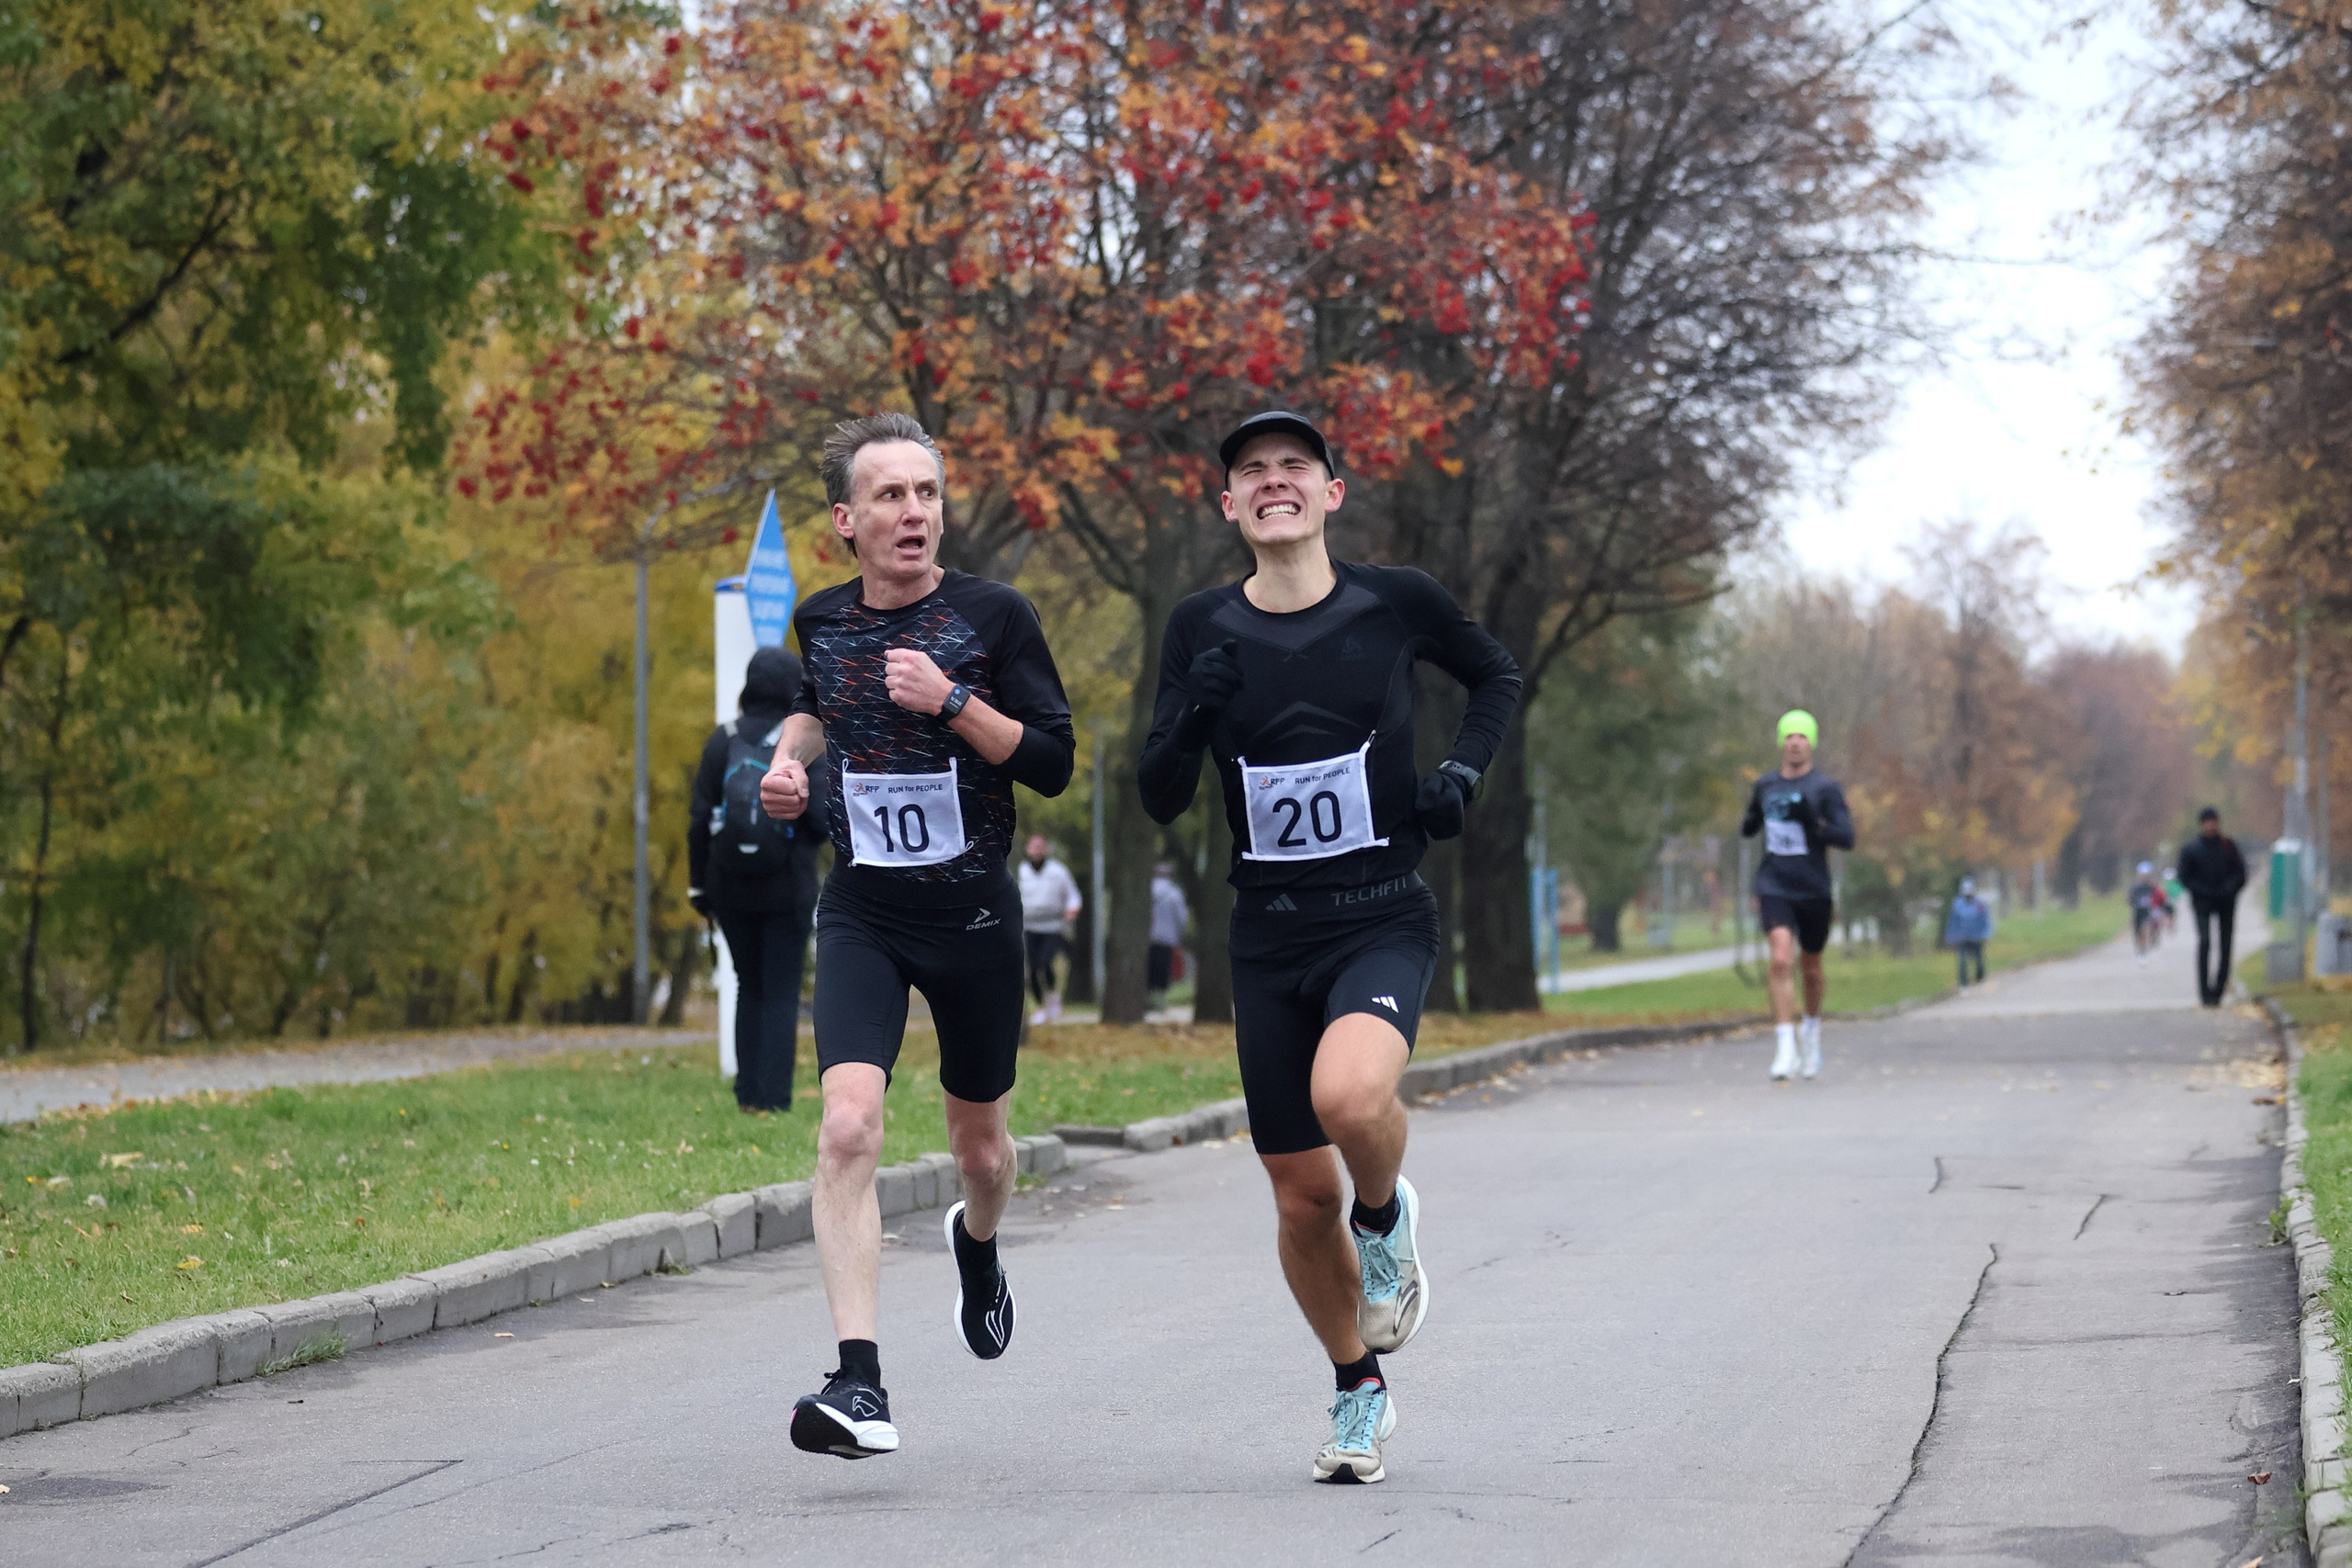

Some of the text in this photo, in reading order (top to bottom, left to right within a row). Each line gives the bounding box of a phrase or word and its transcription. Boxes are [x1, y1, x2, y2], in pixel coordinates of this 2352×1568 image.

[1295, 767, 1350, 785] RUN for PEOPLE
[888, 785, 903, 794] RUN
[915, 784, 943, 792] PEOPLE
[874, 804, 930, 852] 10
[1272, 791, 1342, 848] 20
[1331, 876, 1407, 906] TECHFIT
[966, 919, 1001, 931] DEMIX
